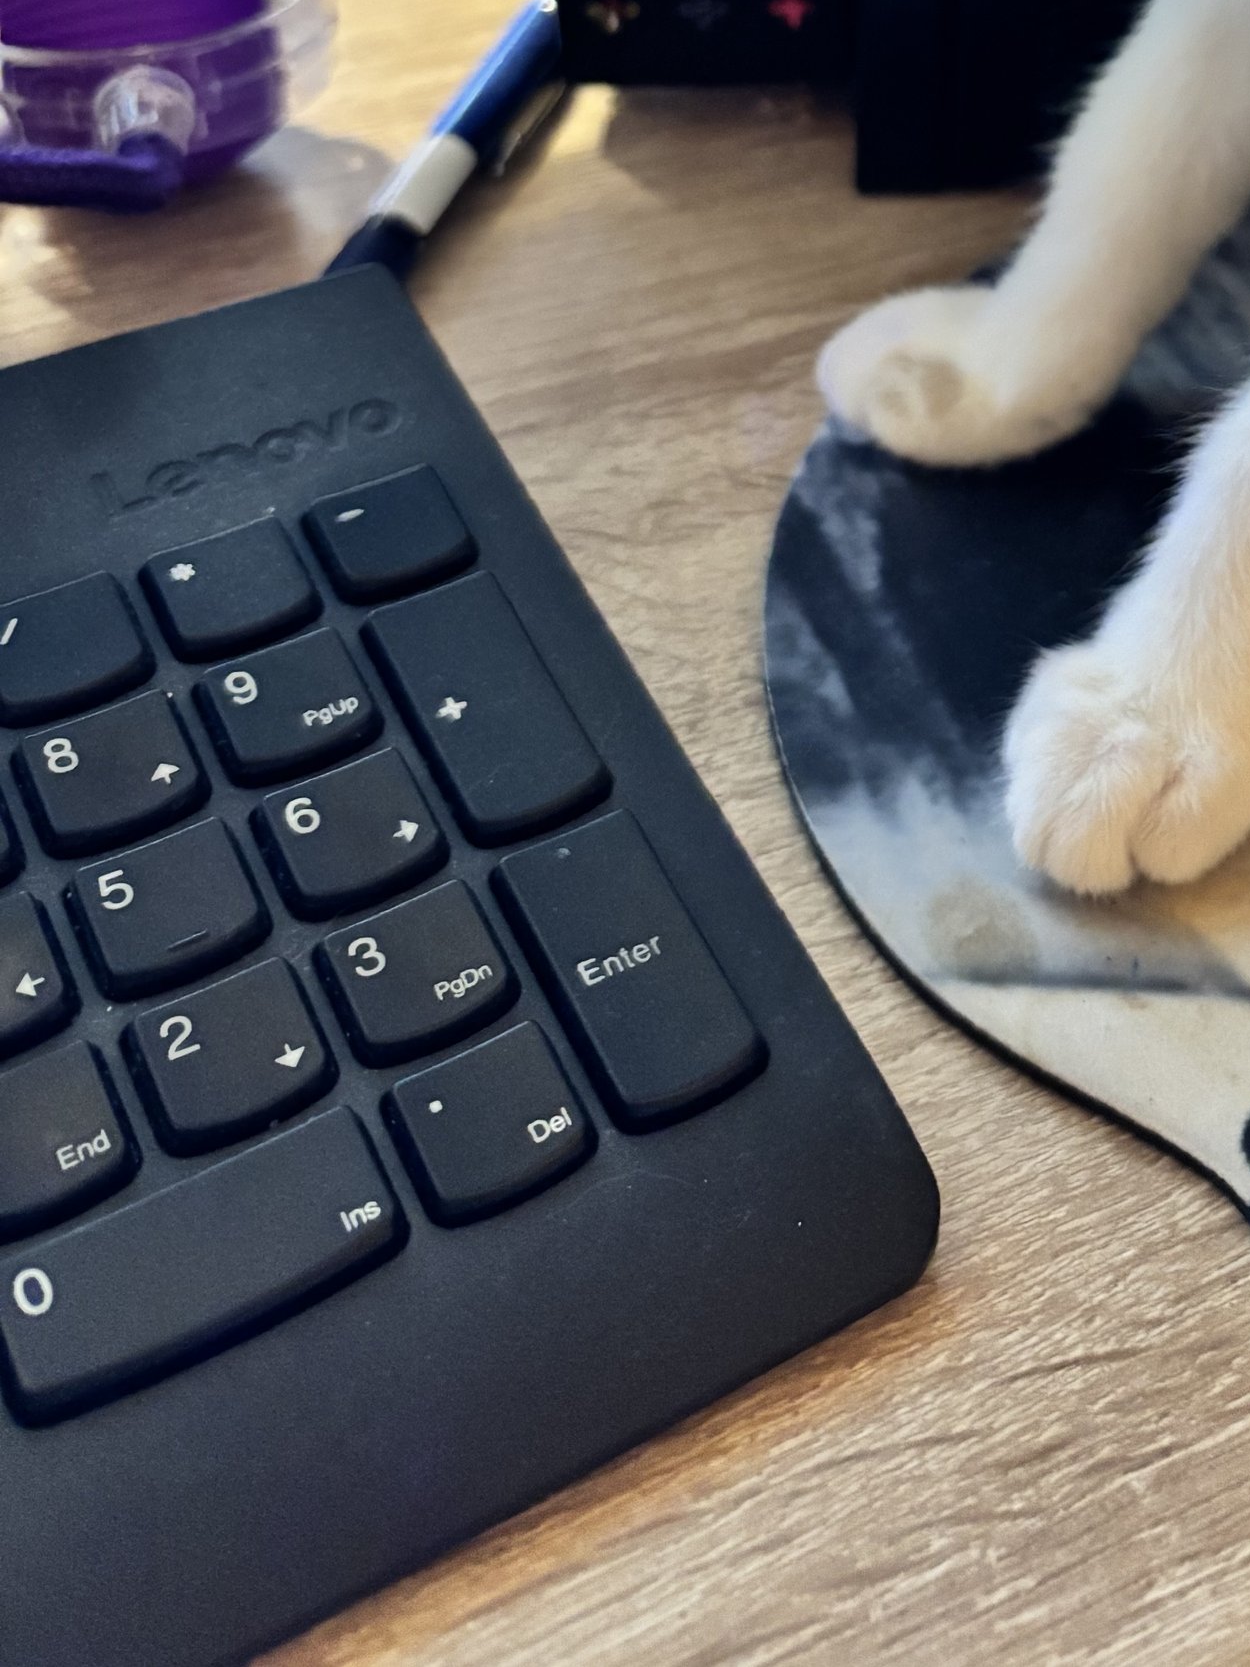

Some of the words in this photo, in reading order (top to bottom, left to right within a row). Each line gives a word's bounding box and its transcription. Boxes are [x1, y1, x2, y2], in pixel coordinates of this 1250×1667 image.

[90, 397, 403, 520] Lenovo
[223, 670, 259, 705] 9
[302, 696, 359, 727] PgUp
[42, 737, 80, 774] 8
[284, 796, 321, 834] 6
[97, 869, 135, 911] 5
[347, 936, 387, 977] 3
[576, 935, 662, 988] Enter
[433, 963, 494, 1001] PgDn
[158, 1014, 202, 1061] 2
[526, 1107, 574, 1144] Del
[55, 1129, 112, 1171] End
[339, 1200, 382, 1232] Ins
[12, 1267, 54, 1317] 0
